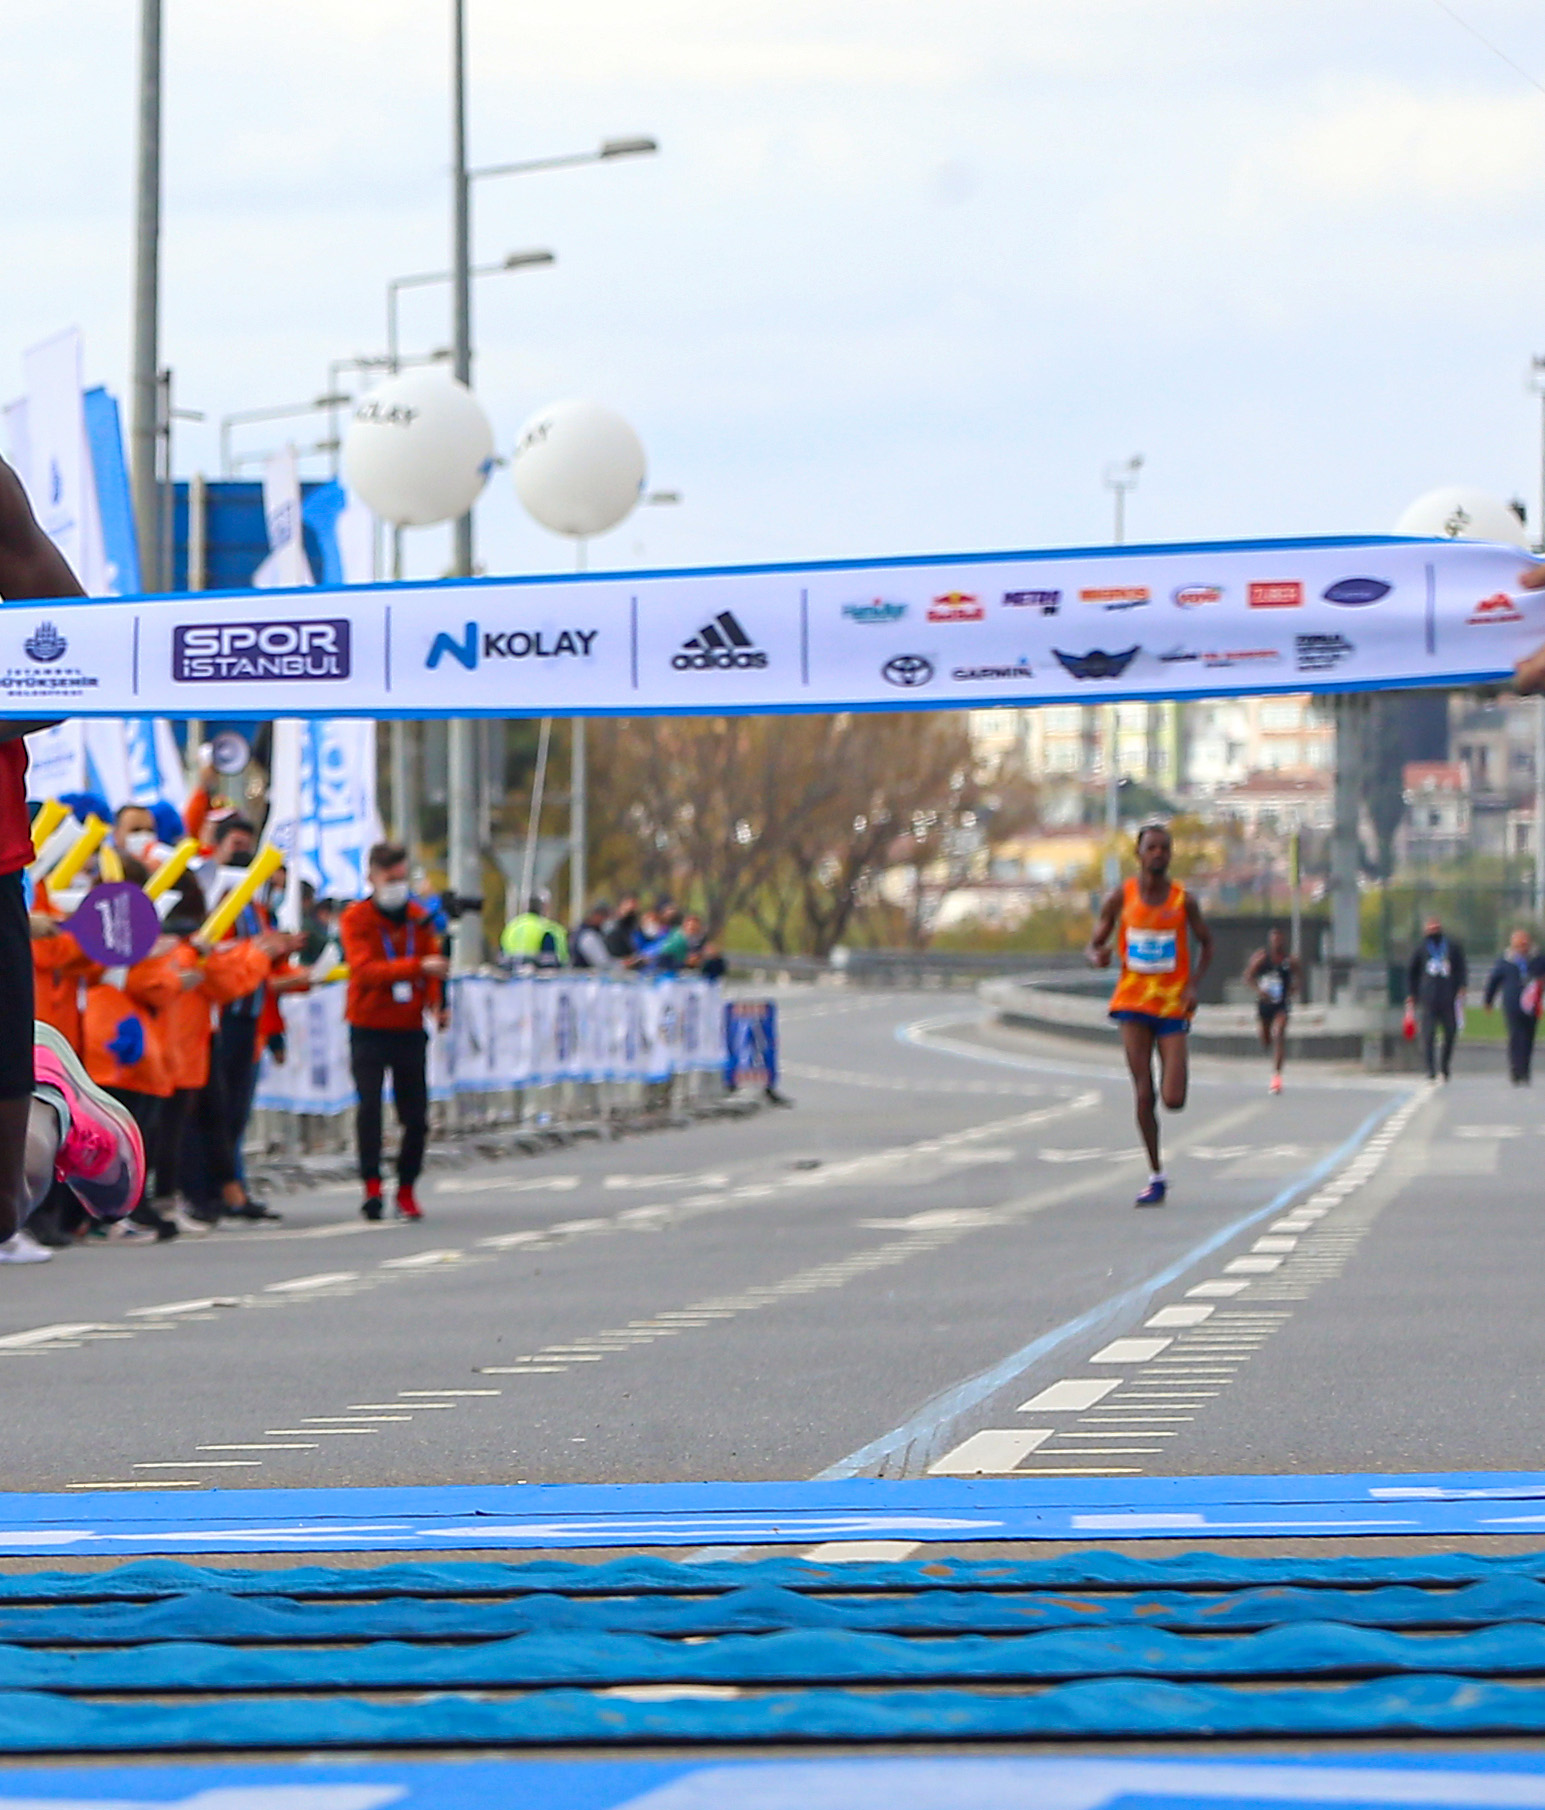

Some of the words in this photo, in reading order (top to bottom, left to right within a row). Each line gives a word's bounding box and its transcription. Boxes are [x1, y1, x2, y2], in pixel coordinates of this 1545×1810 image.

[183, 624, 339, 657] SPOR
[483, 629, 598, 659] KOLAY
[671, 651, 769, 670] adidas
